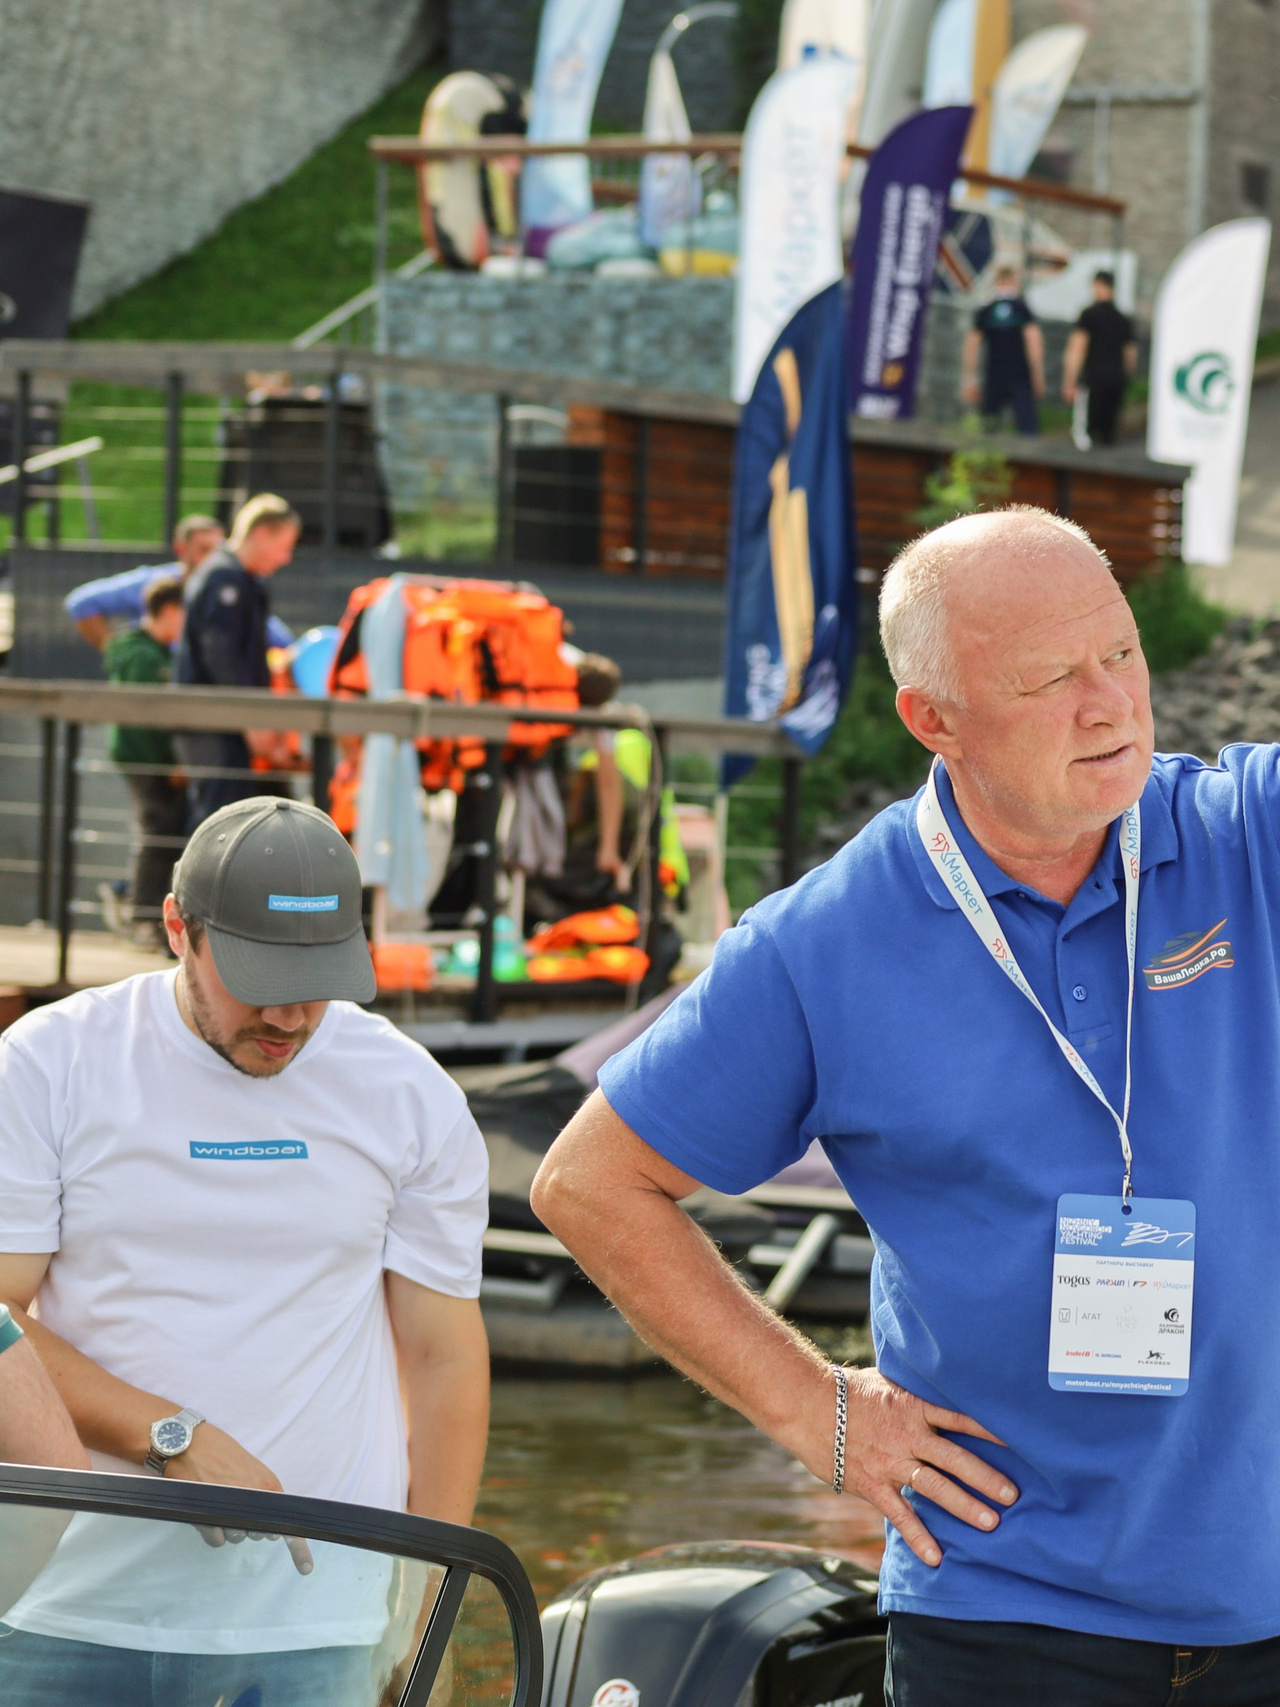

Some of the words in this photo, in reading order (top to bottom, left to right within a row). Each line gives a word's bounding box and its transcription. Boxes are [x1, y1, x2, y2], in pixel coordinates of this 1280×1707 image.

[273, 900, 335, 909] windboat
[1153, 947, 1227, 985] ВашаЛодка.РФ
[194, 1145, 304, 1156] windboat
[1060, 1223, 1112, 1233] NOVGOROD
[1060, 1230, 1103, 1239] YACHTING
[1060, 1237, 1099, 1246] FESTIVAL
[1081, 1312, 1102, 1321] АГАТ
[1065, 1379, 1172, 1391] motorboat.ru/nnyachtingfestival
